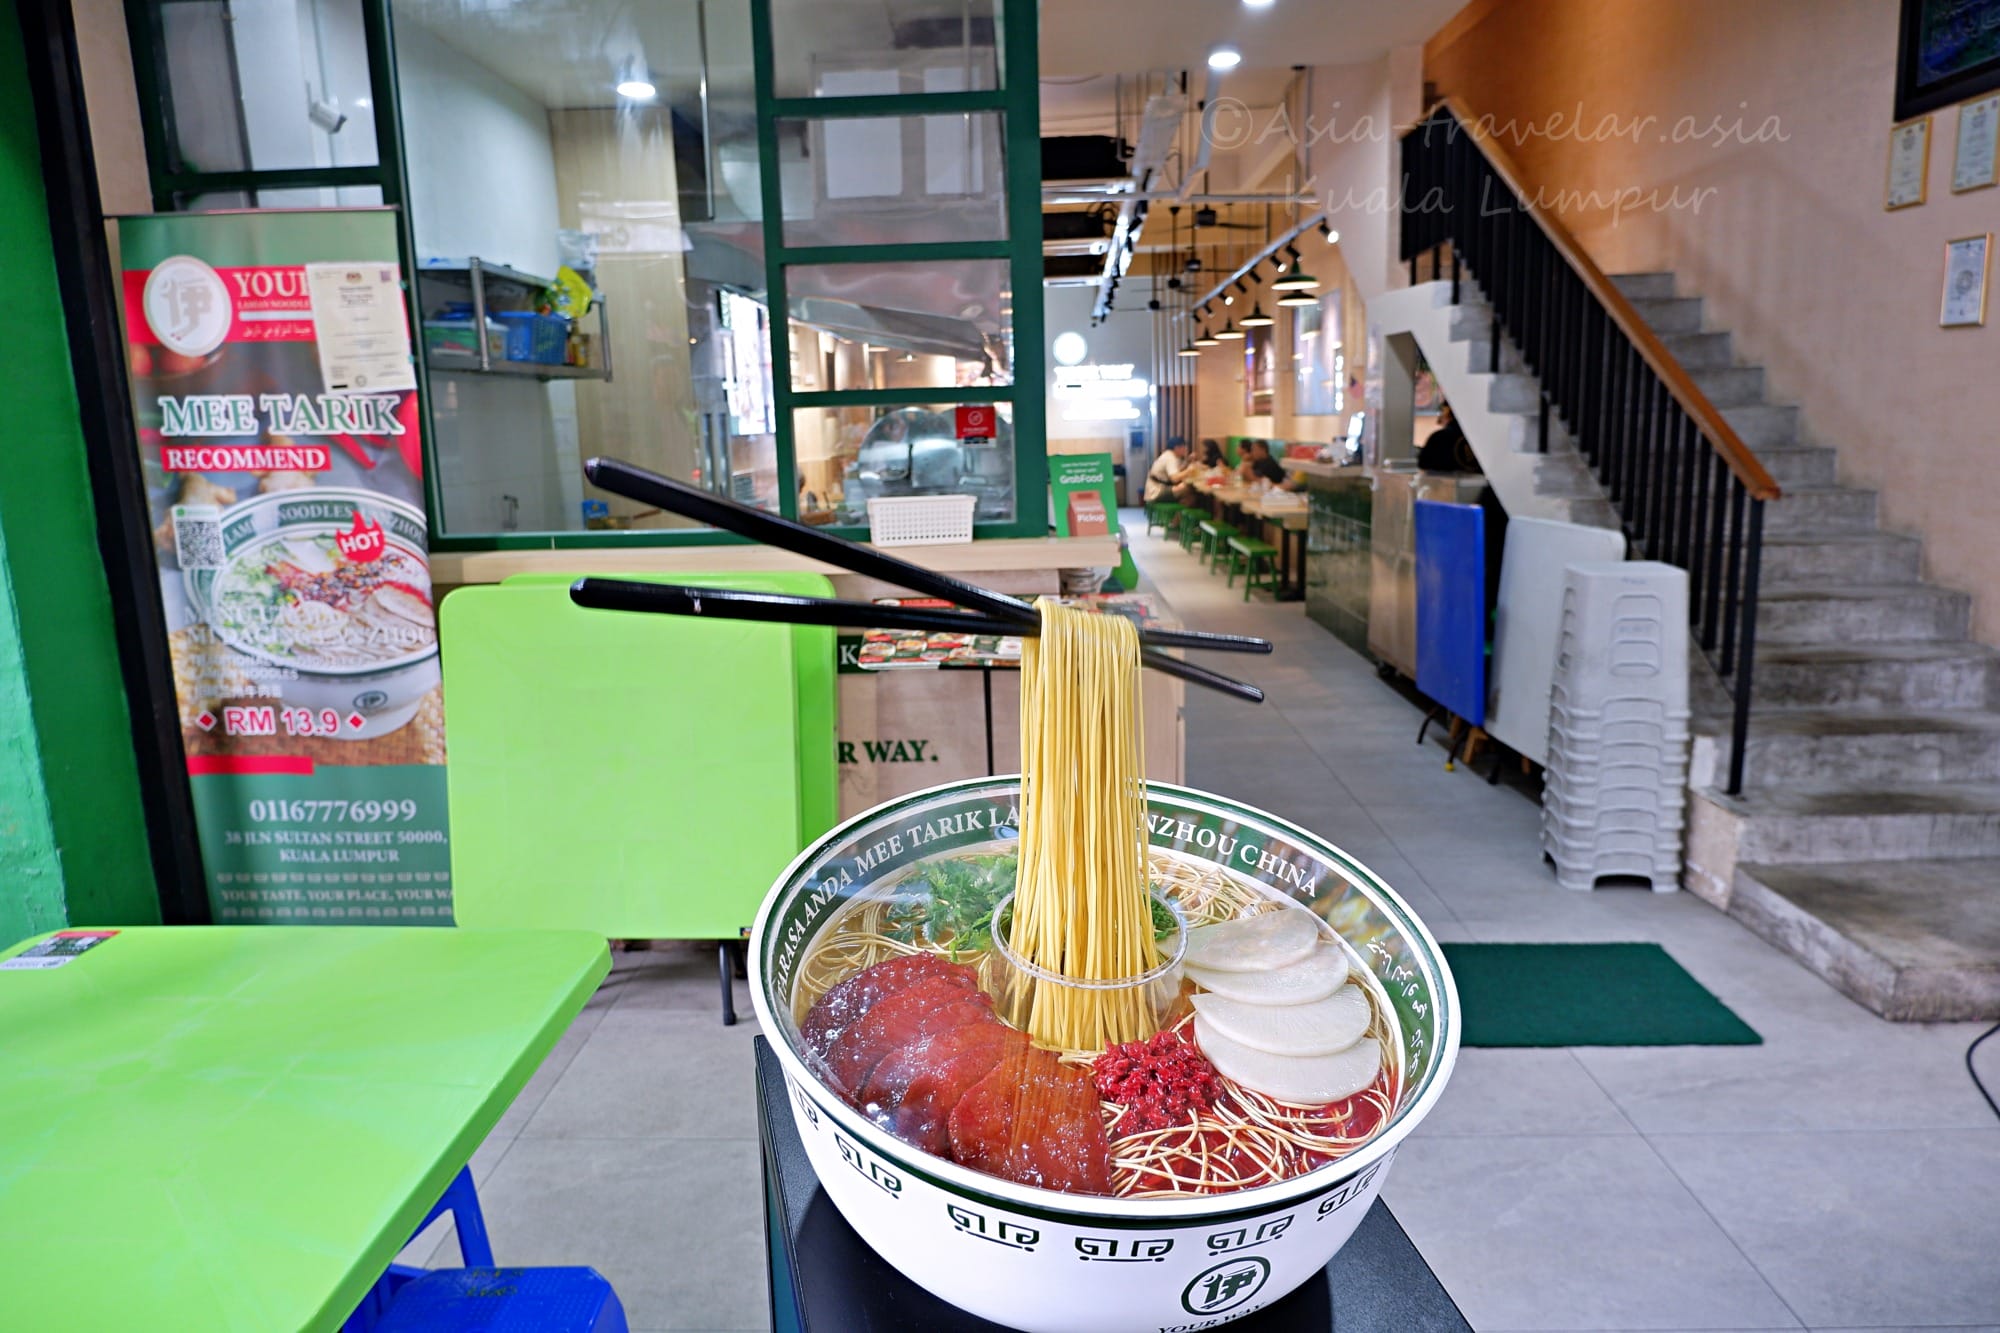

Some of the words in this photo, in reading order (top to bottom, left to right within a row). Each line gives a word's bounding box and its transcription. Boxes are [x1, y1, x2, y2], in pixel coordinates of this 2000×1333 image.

[159, 395, 257, 435] MEE
[262, 394, 404, 435] TARIK
[167, 449, 326, 470] RECOMMEND
[1059, 473, 1104, 485] GrabFood
[341, 531, 380, 553] HOT
[224, 707, 275, 735] RM
[282, 708, 340, 736] 13.9
[862, 740, 938, 763] WAY.
[250, 800, 417, 822] 01167776999
[274, 831, 332, 845] SULTAN
[335, 831, 393, 844] STREET
[279, 849, 331, 863] KUALA
[333, 849, 399, 863] LUMPUR
[803, 867, 853, 926] ANDA
[854, 835, 904, 878] MEE
[906, 809, 984, 848] TARIK
[988, 806, 1019, 828] LA
[1140, 813, 1238, 855] NZHOU
[1240, 844, 1316, 898] CHINA
